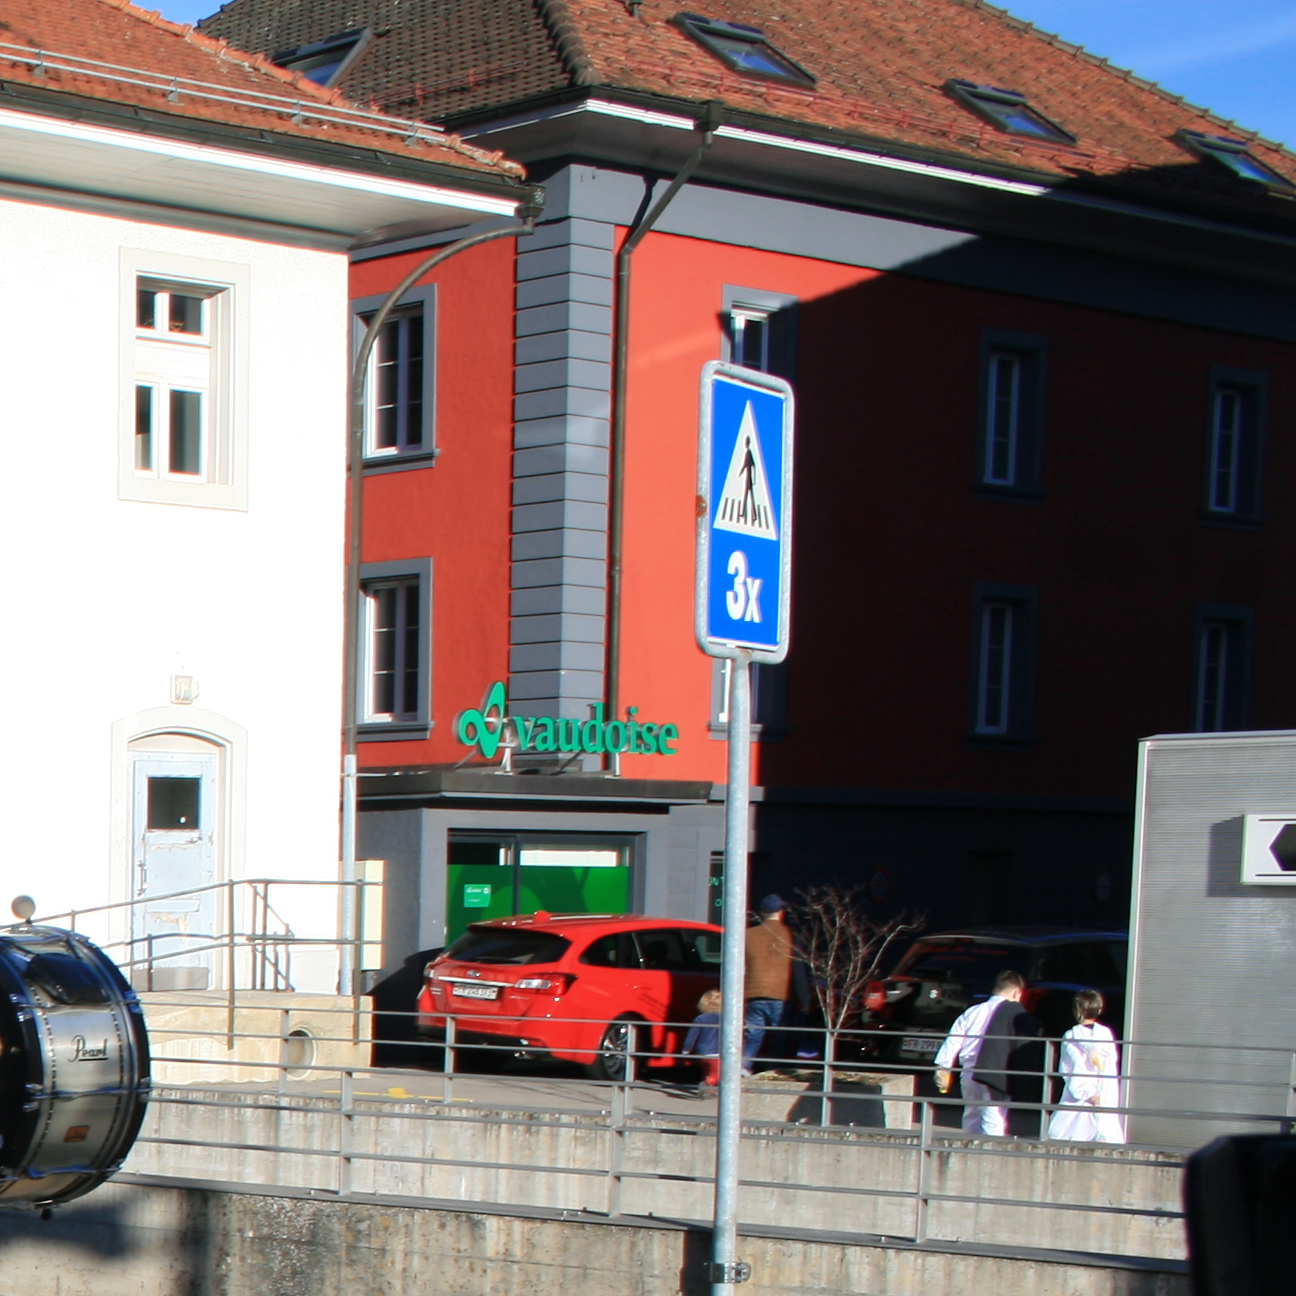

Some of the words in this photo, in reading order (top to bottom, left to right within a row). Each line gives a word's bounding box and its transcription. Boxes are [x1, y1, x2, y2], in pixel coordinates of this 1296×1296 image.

[726, 550, 762, 624] 3x
[513, 702, 679, 756] vaudoise
[68, 1035, 108, 1062] Pearl
